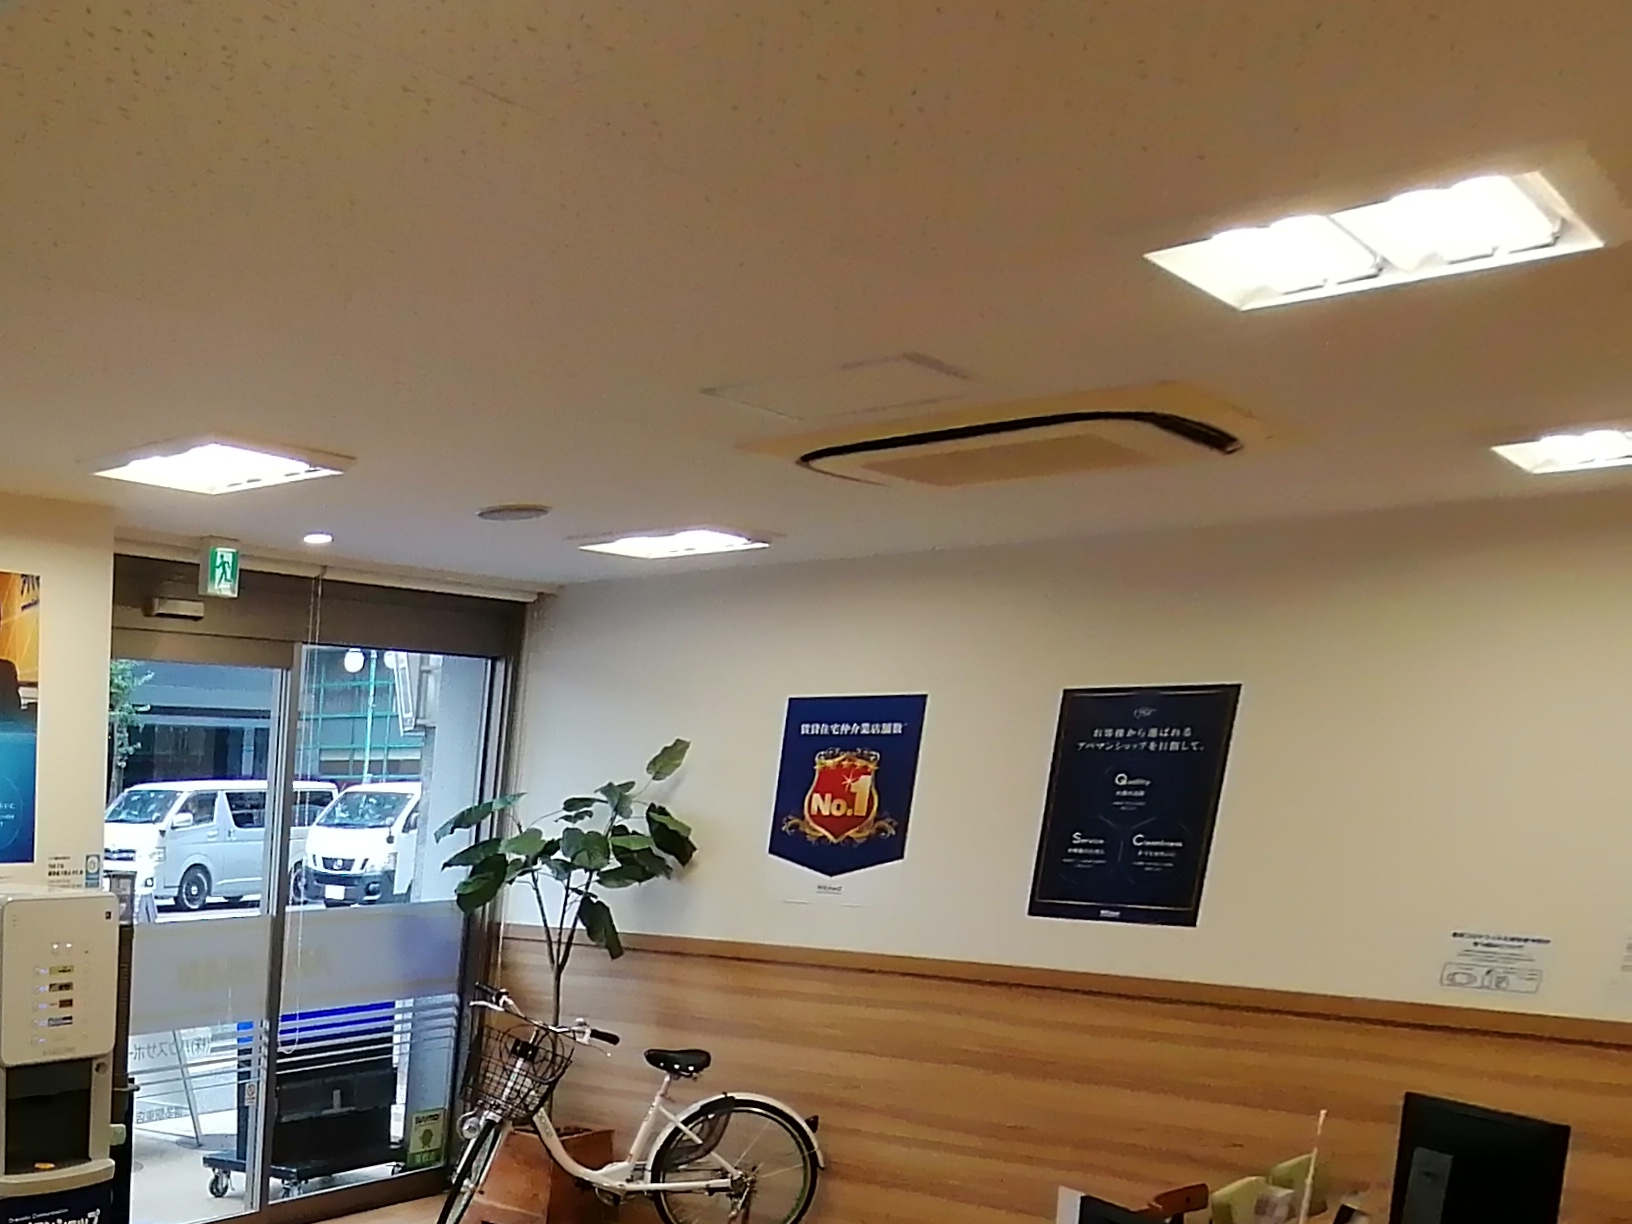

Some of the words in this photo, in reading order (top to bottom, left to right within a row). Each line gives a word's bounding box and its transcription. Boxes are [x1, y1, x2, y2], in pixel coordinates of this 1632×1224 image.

[1093, 727, 1192, 739] お客様から選ばれる
[810, 774, 873, 817] No.1
